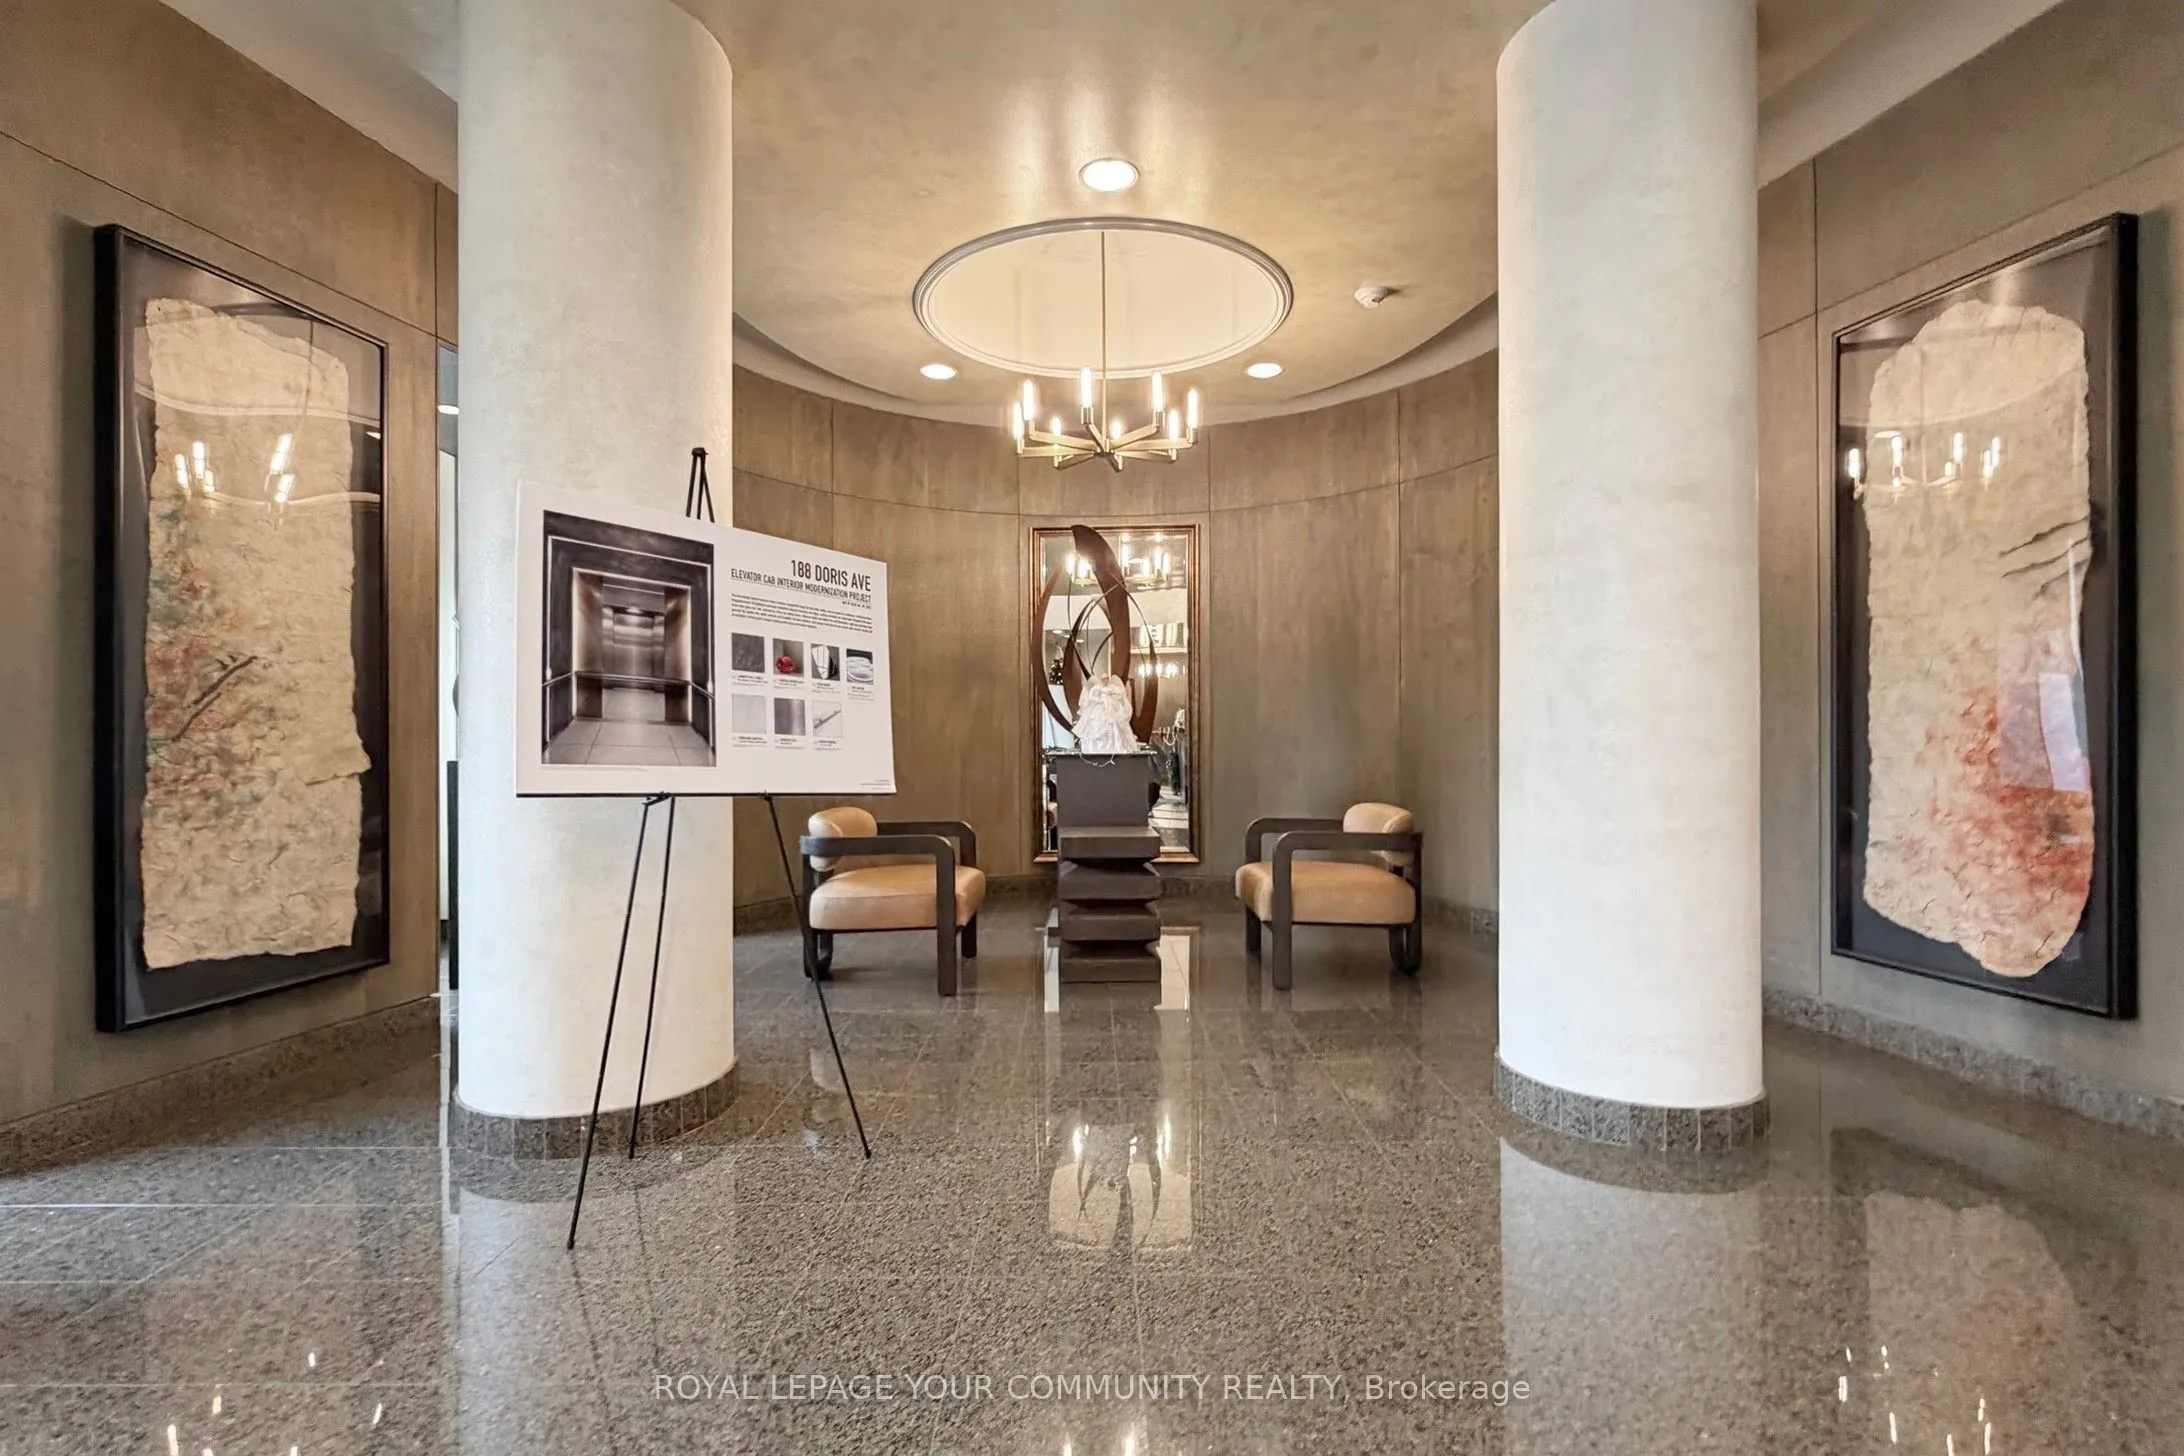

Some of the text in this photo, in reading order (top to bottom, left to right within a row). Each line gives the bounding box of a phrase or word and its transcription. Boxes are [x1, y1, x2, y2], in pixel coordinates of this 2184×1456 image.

[731, 568, 871, 603] ELEVATOR CAB INTERIOR MODERNIZATION PROJECT
[791, 560, 871, 592] 188 DORIS AVE
